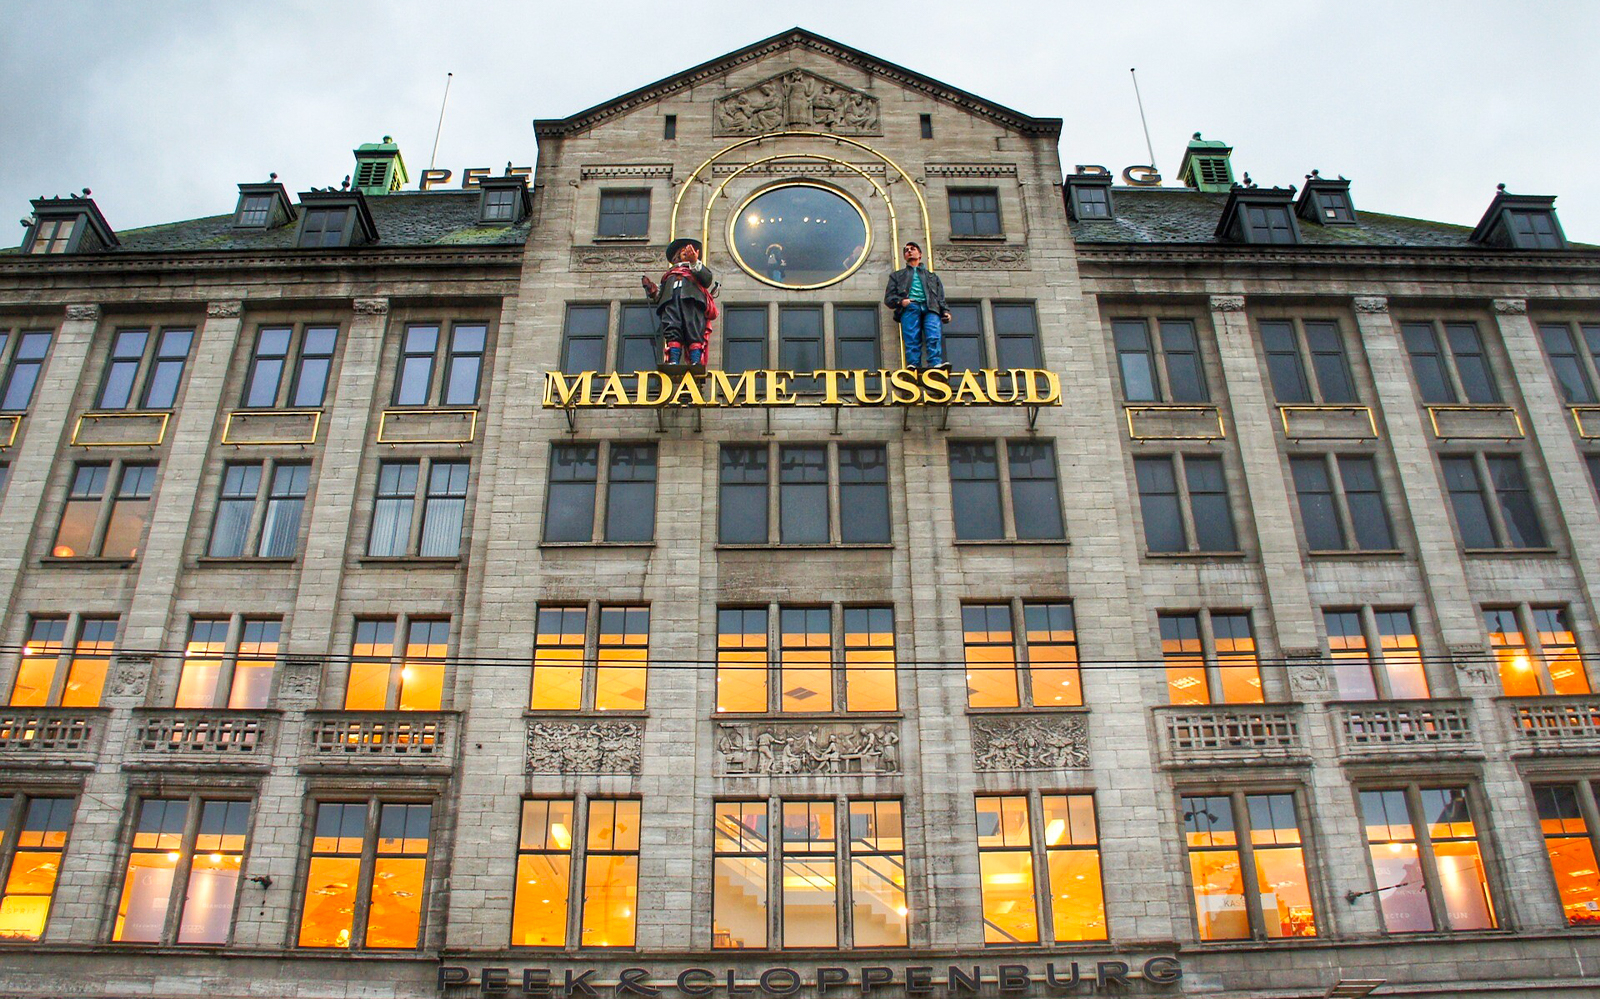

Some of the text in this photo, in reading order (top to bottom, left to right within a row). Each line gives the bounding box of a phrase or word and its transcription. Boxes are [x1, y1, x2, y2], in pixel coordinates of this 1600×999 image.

[543, 368, 1062, 407] MADAME TUSSAUD
[437, 956, 1184, 997] PEEK & CLOPPENBURG
